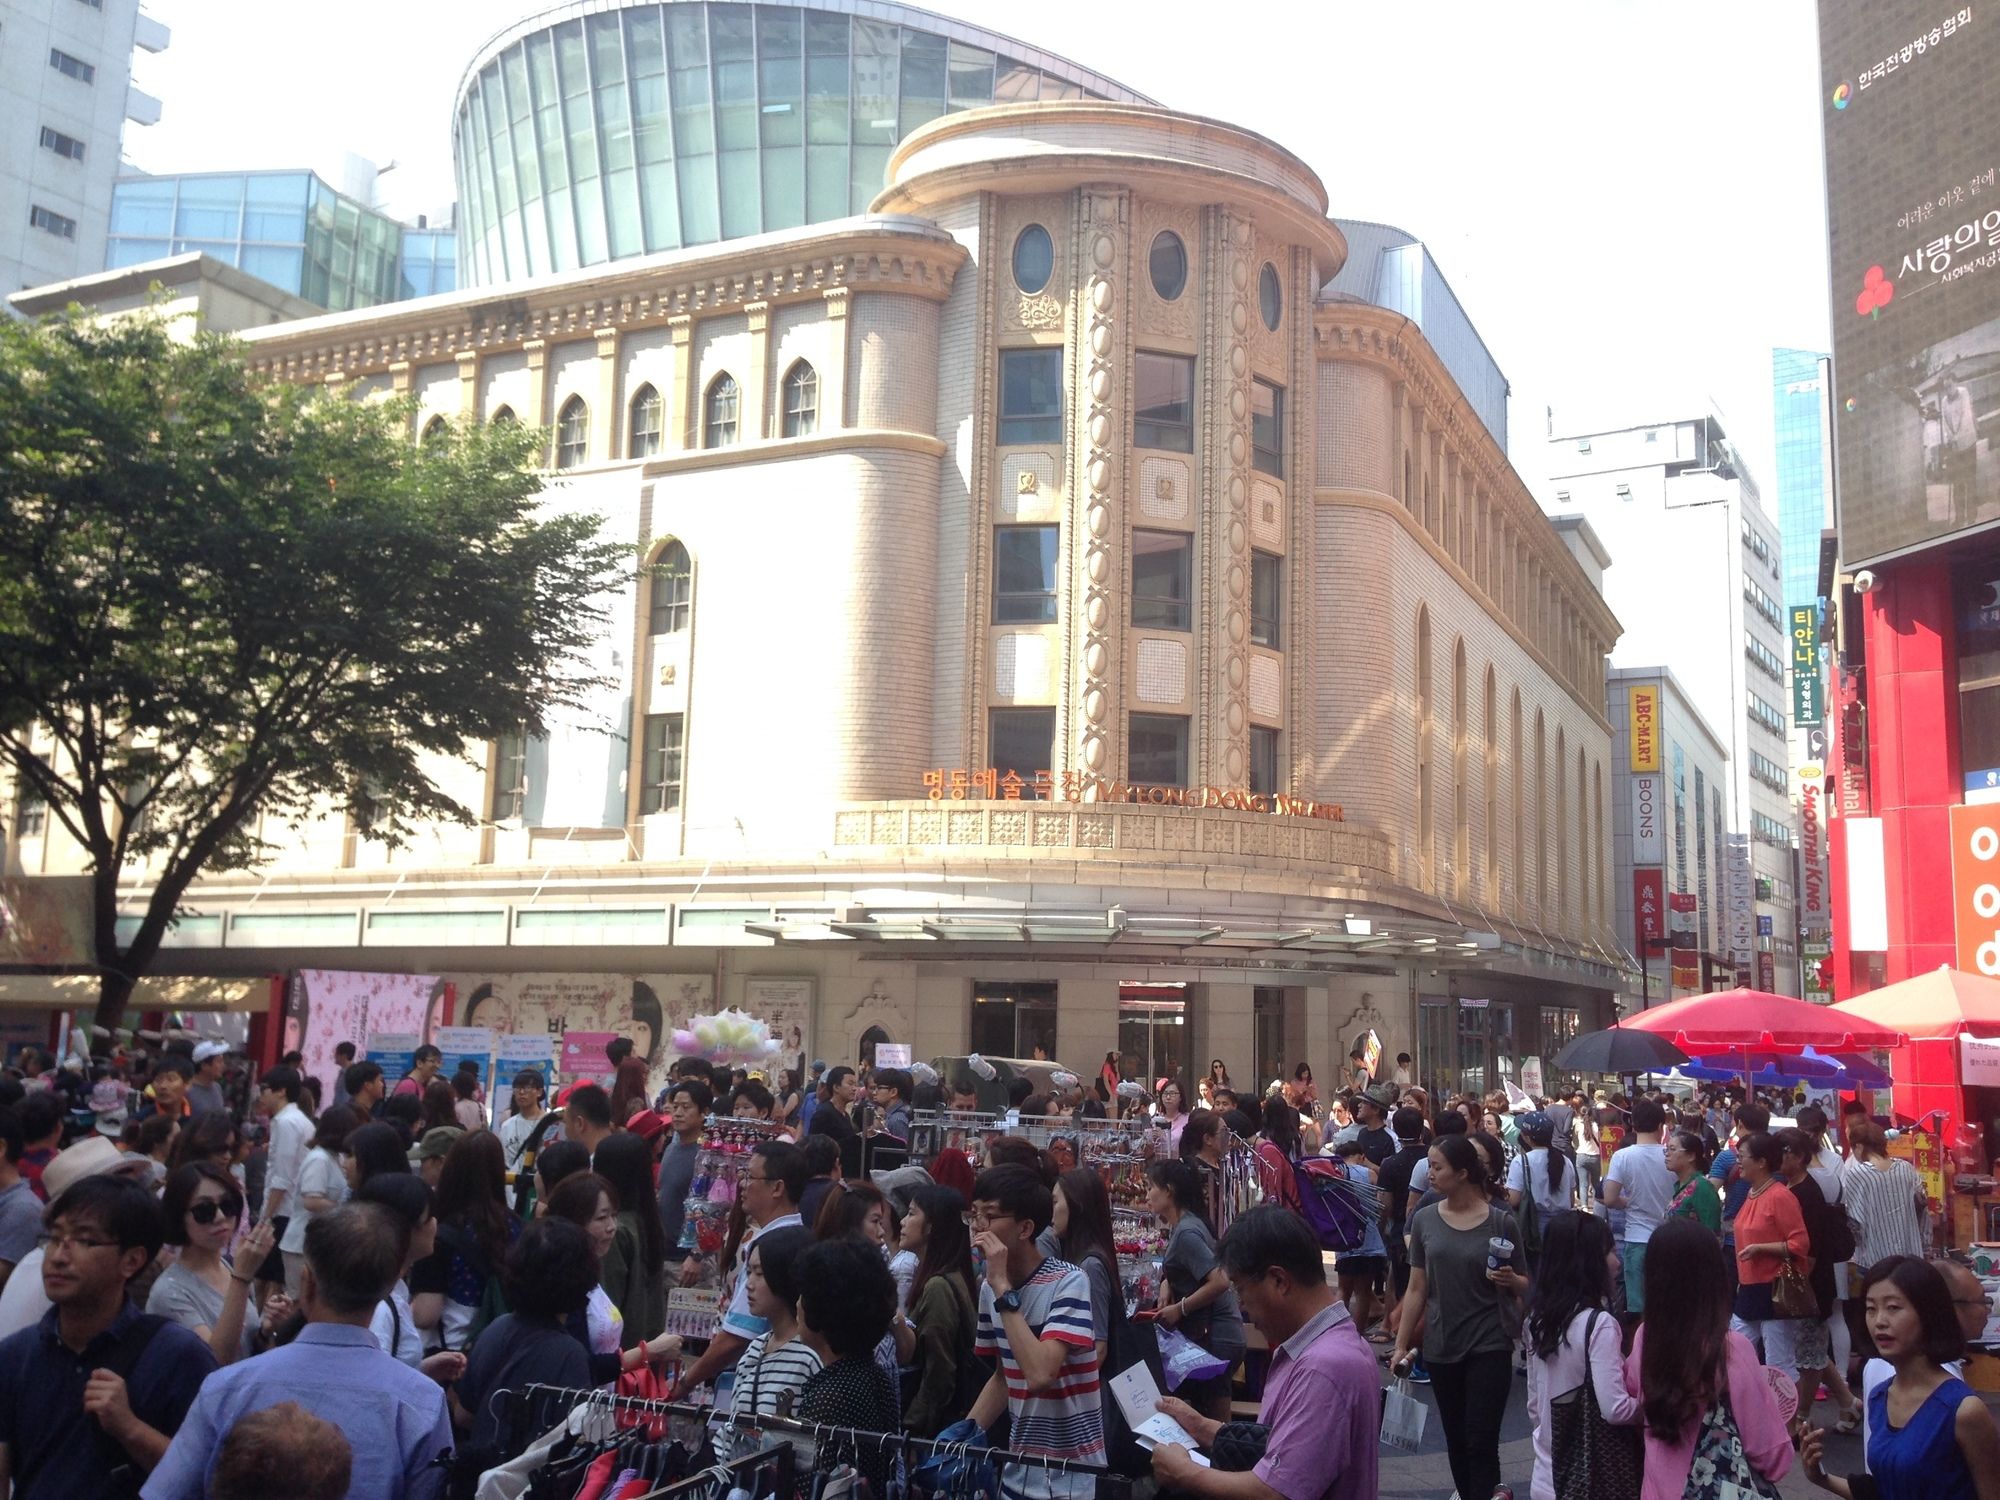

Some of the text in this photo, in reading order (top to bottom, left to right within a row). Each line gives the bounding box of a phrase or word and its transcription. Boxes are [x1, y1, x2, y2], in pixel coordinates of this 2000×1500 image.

[1859, 6, 1972, 91] 한국전광방송협회
[1897, 202, 1934, 230] 어려운
[1938, 186, 1965, 208] 이웃
[1794, 608, 1815, 666] 티안나
[1636, 693, 1651, 764] ABC-MART
[923, 767, 1083, 803] 명동예술극장
[1638, 779, 1653, 838] BOONS
[1803, 783, 1820, 866] SMOOTHIE
